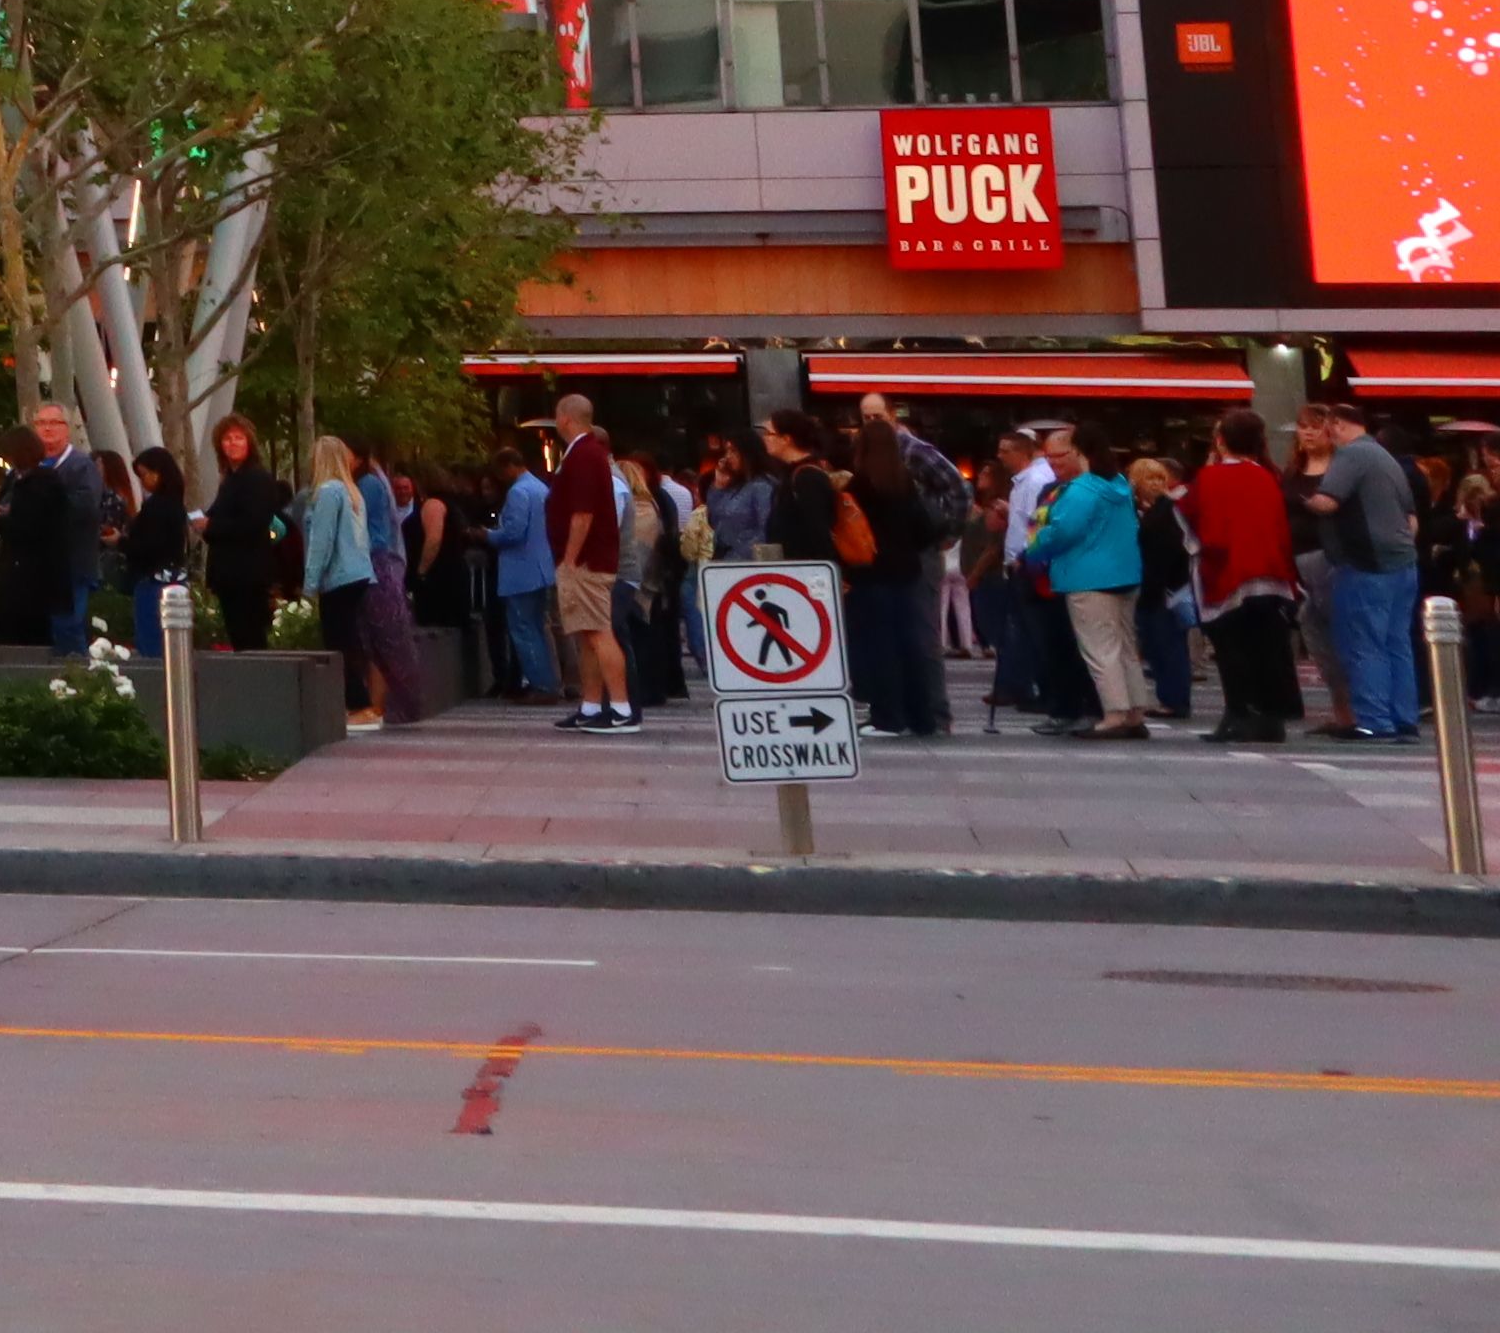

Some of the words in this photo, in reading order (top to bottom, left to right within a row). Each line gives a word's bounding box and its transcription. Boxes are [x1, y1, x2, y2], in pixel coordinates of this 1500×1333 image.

[1187, 34, 1221, 52] JBL
[893, 133, 1039, 157] WOLFGANG
[895, 163, 1051, 224] PUCK
[899, 239, 944, 252] BAR
[952, 241, 964, 252] &
[972, 239, 1050, 252] GRILL
[732, 710, 779, 735] USE
[729, 741, 852, 769] CROSSWALK
